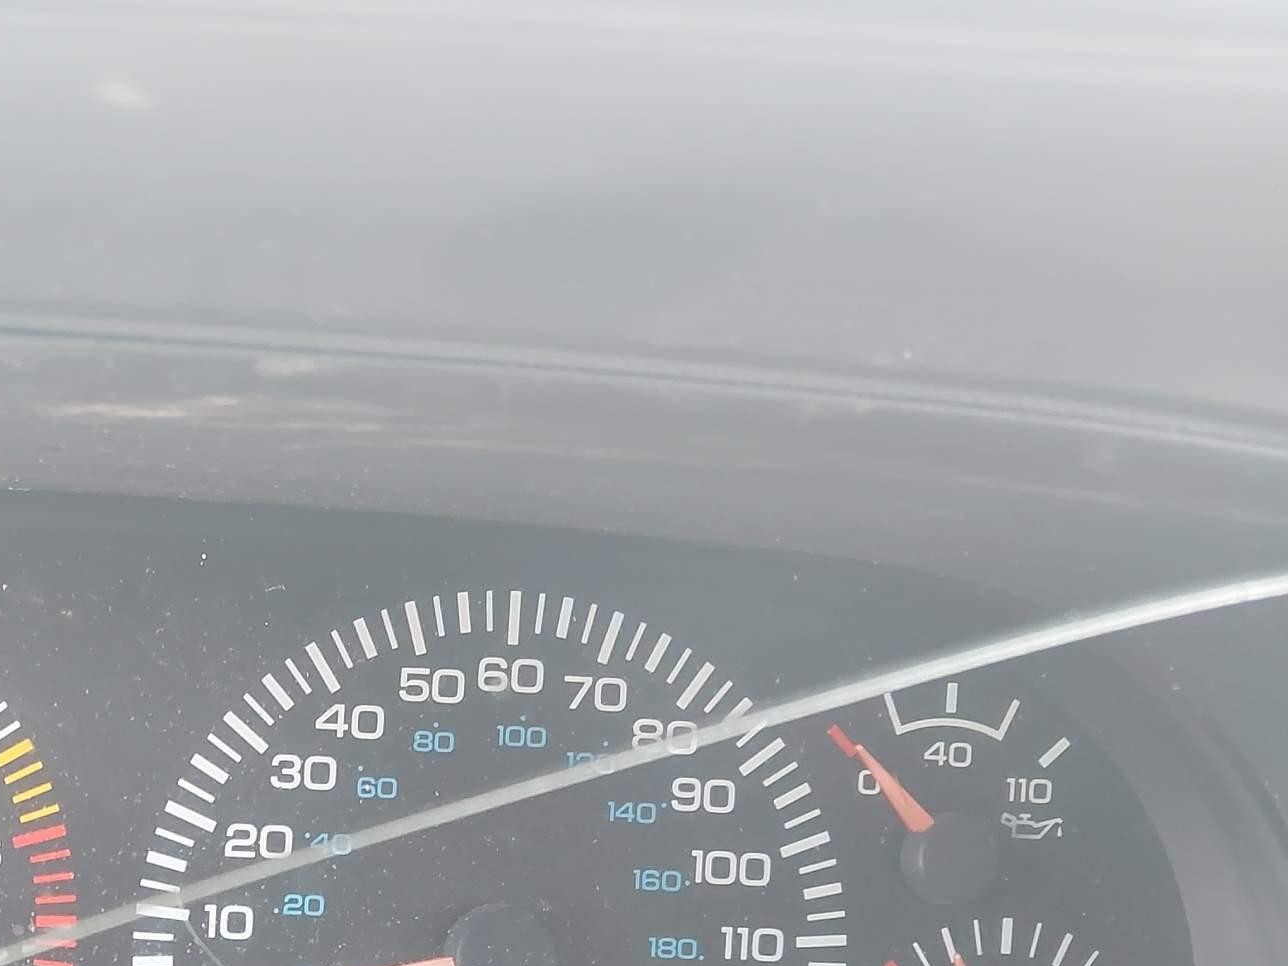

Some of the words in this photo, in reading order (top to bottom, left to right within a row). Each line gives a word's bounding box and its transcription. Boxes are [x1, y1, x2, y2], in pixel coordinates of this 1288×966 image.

[398, 667, 465, 704] 50
[476, 657, 544, 694] 60
[564, 675, 628, 712] 70
[315, 704, 385, 740] 40
[496, 725, 547, 748] 100
[631, 718, 699, 755] 80
[413, 731, 455, 753] 80
[923, 741, 973, 768] 40
[270, 754, 338, 791] 30
[357, 776, 398, 800] 60
[857, 770, 880, 795] 0
[671, 777, 736, 814] 90
[1006, 777, 1053, 803] 110
[607, 801, 656, 824] 140
[224, 823, 293, 858] 20
[312, 831, 352, 856] 40
[633, 869, 683, 892] 160
[691, 850, 771, 887] 100
[283, 895, 325, 917] 20
[205, 905, 253, 940] 10
[648, 937, 697, 960] 180
[720, 927, 784, 963] 110
